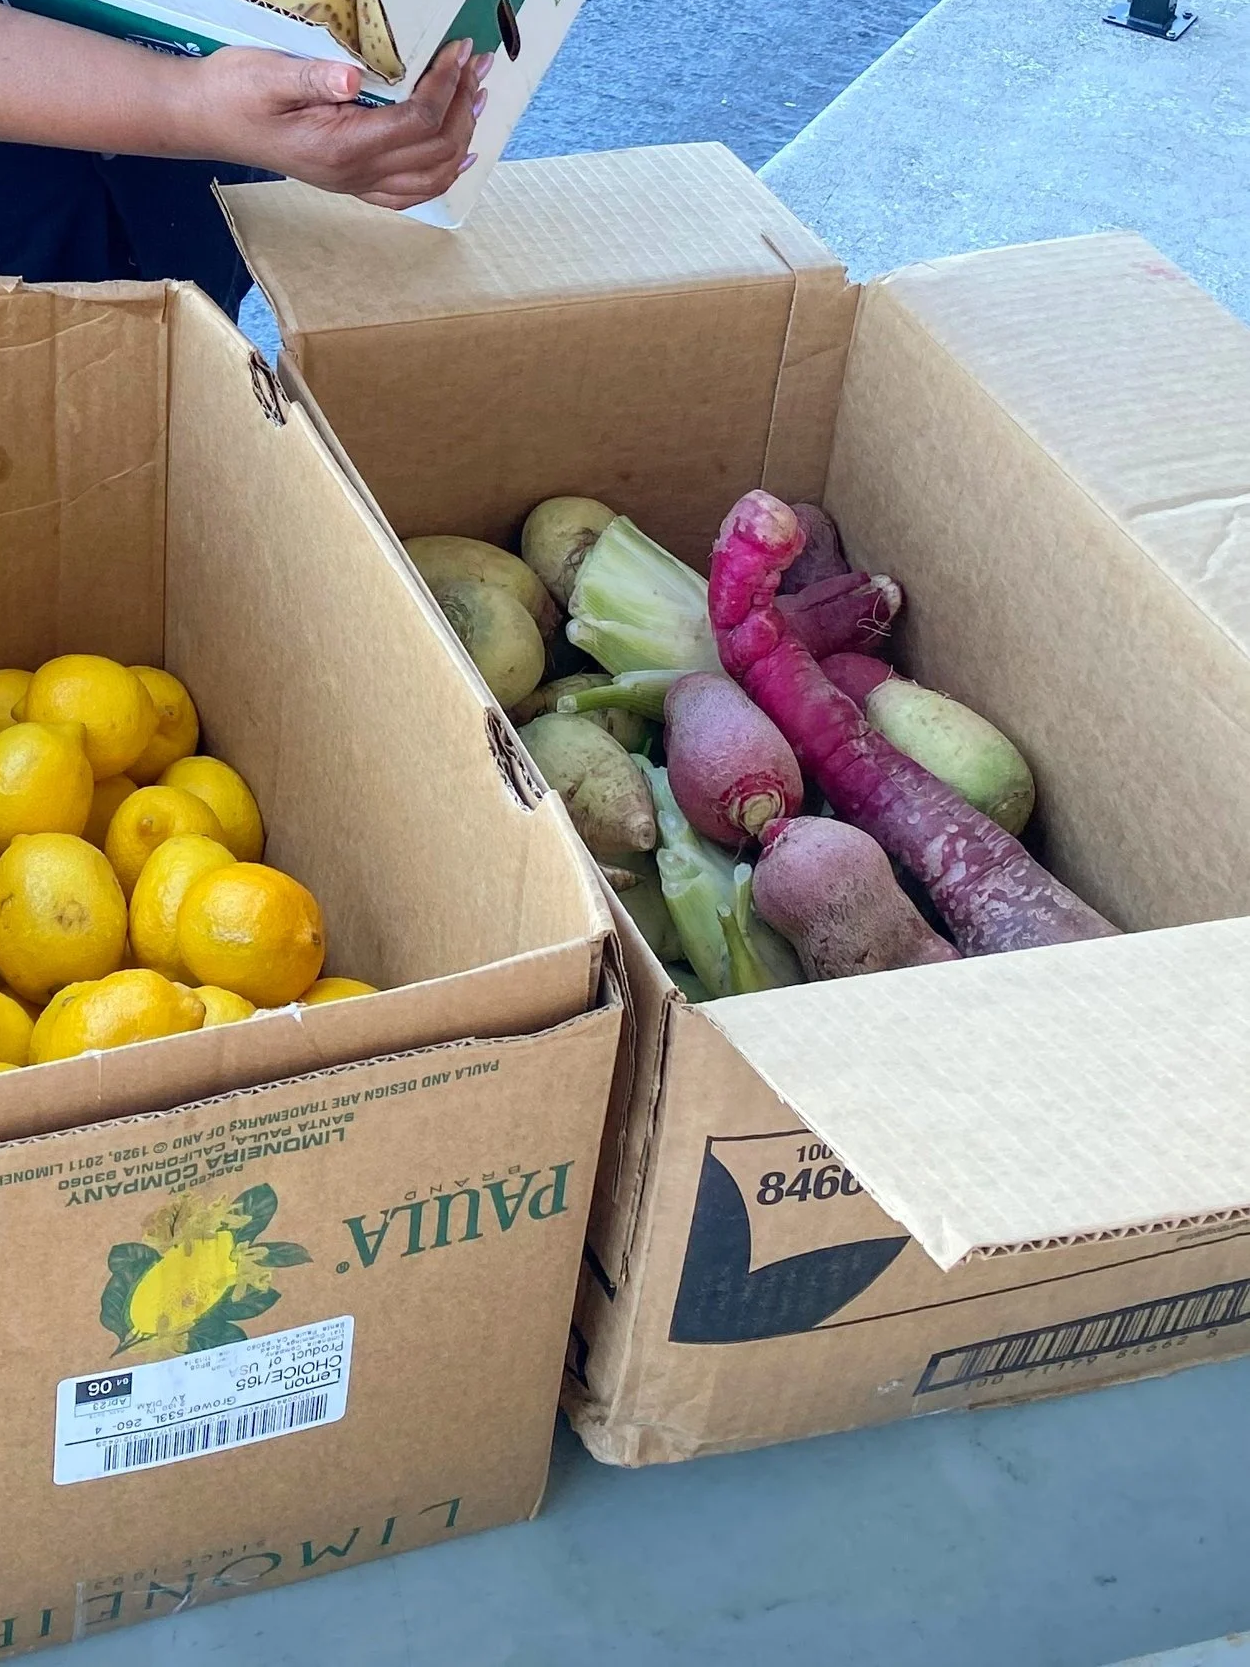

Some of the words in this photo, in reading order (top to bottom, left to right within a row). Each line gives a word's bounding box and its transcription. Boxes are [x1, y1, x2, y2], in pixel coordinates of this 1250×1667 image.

[422, 1071, 451, 1088] AND
[456, 1059, 500, 1081] PAULA
[332, 1091, 361, 1109] ARE
[365, 1078, 418, 1102] DESIGN
[229, 1098, 328, 1132] TRADEMARKS
[298, 1111, 355, 1131] SANTA
[172, 1130, 202, 1151] AND
[206, 1124, 225, 1142] OF
[206, 1126, 346, 1169] LIMONEIRA
[69, 1155, 104, 1173] 2011
[123, 1141, 226, 1177] CALIFORNIA
[58, 1169, 118, 1191] 93060
[65, 1161, 199, 1208] COMPANY
[189, 1163, 244, 1189] PACKED
[404, 1165, 521, 1201] BRAND
[268, 1356, 282, 1368] of
[292, 1340, 344, 1362] Product
[229, 1361, 259, 1378] USA
[236, 1354, 343, 1392] CHOICE/165
[284, 1367, 342, 1390] Lemon
[87, 1379, 113, 1396] 06
[92, 1396, 127, 1411] Apr23
[152, 1410, 185, 1424] 533L
